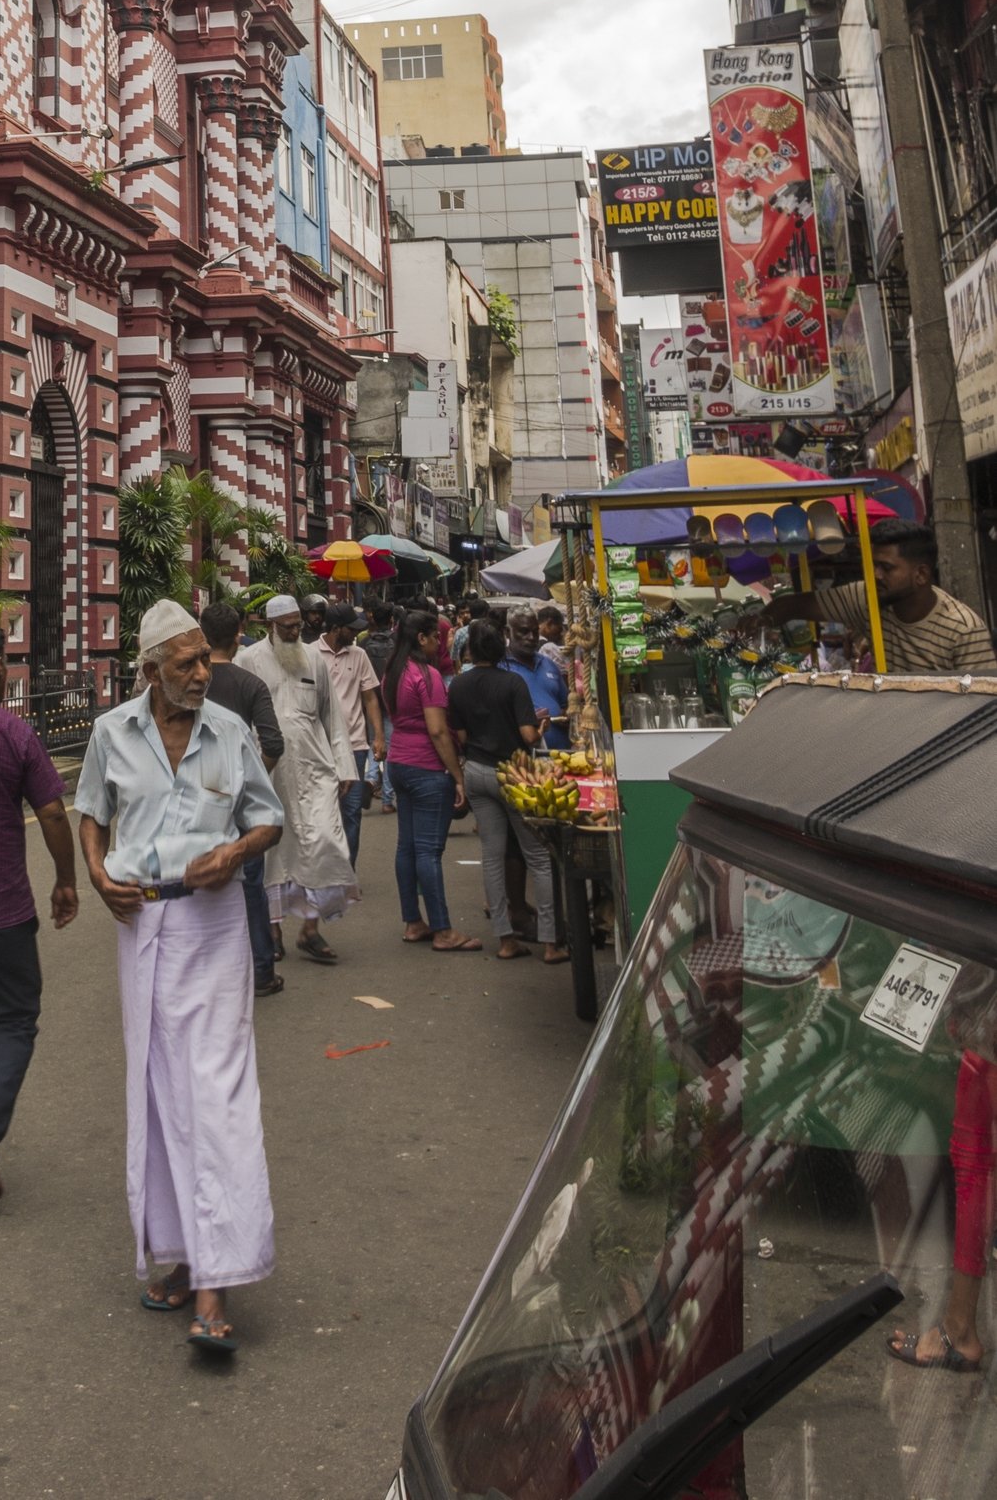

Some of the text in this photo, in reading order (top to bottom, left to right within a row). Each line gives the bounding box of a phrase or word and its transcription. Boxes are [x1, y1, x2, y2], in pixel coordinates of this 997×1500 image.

[712, 48, 794, 73] Hong Kong
[709, 71, 793, 86] Selection
[634, 145, 710, 169] HP Mo
[623, 186, 658, 200] 215/3
[605, 197, 718, 225] HAPPY COR
[617, 227, 647, 235] Importers
[655, 223, 673, 232] Fancy
[646, 232, 664, 242] Tel:
[666, 231, 688, 240] 0112
[761, 399, 784, 409] 215
[884, 974, 910, 996] AAG
[909, 984, 940, 1010] 7791
